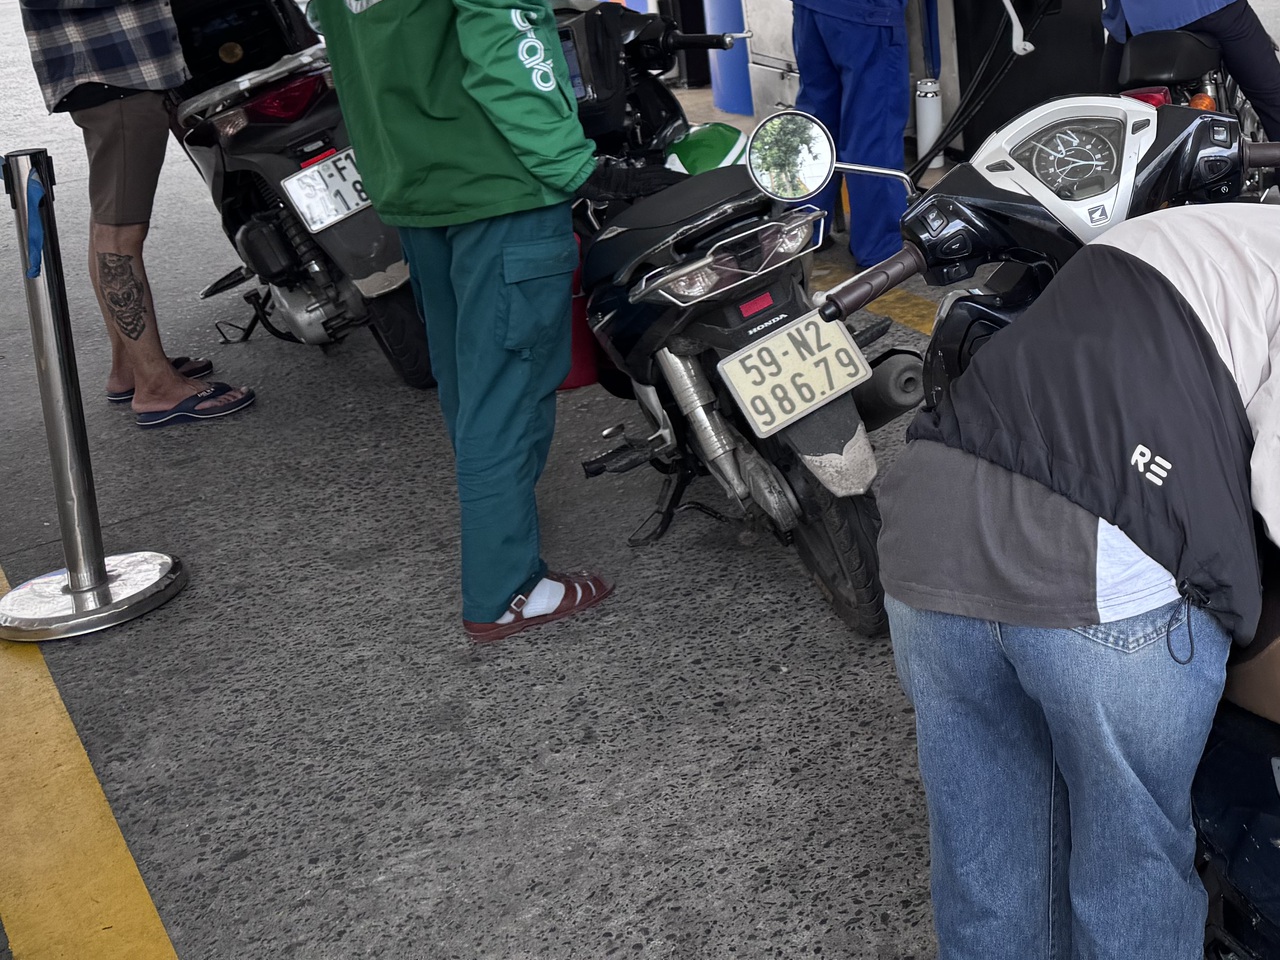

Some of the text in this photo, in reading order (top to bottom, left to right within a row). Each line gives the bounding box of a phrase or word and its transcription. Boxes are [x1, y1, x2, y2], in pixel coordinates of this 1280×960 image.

[739, 321, 831, 387] 59-N2
[748, 313, 788, 336] HONDA
[750, 348, 861, 427] 986.79
